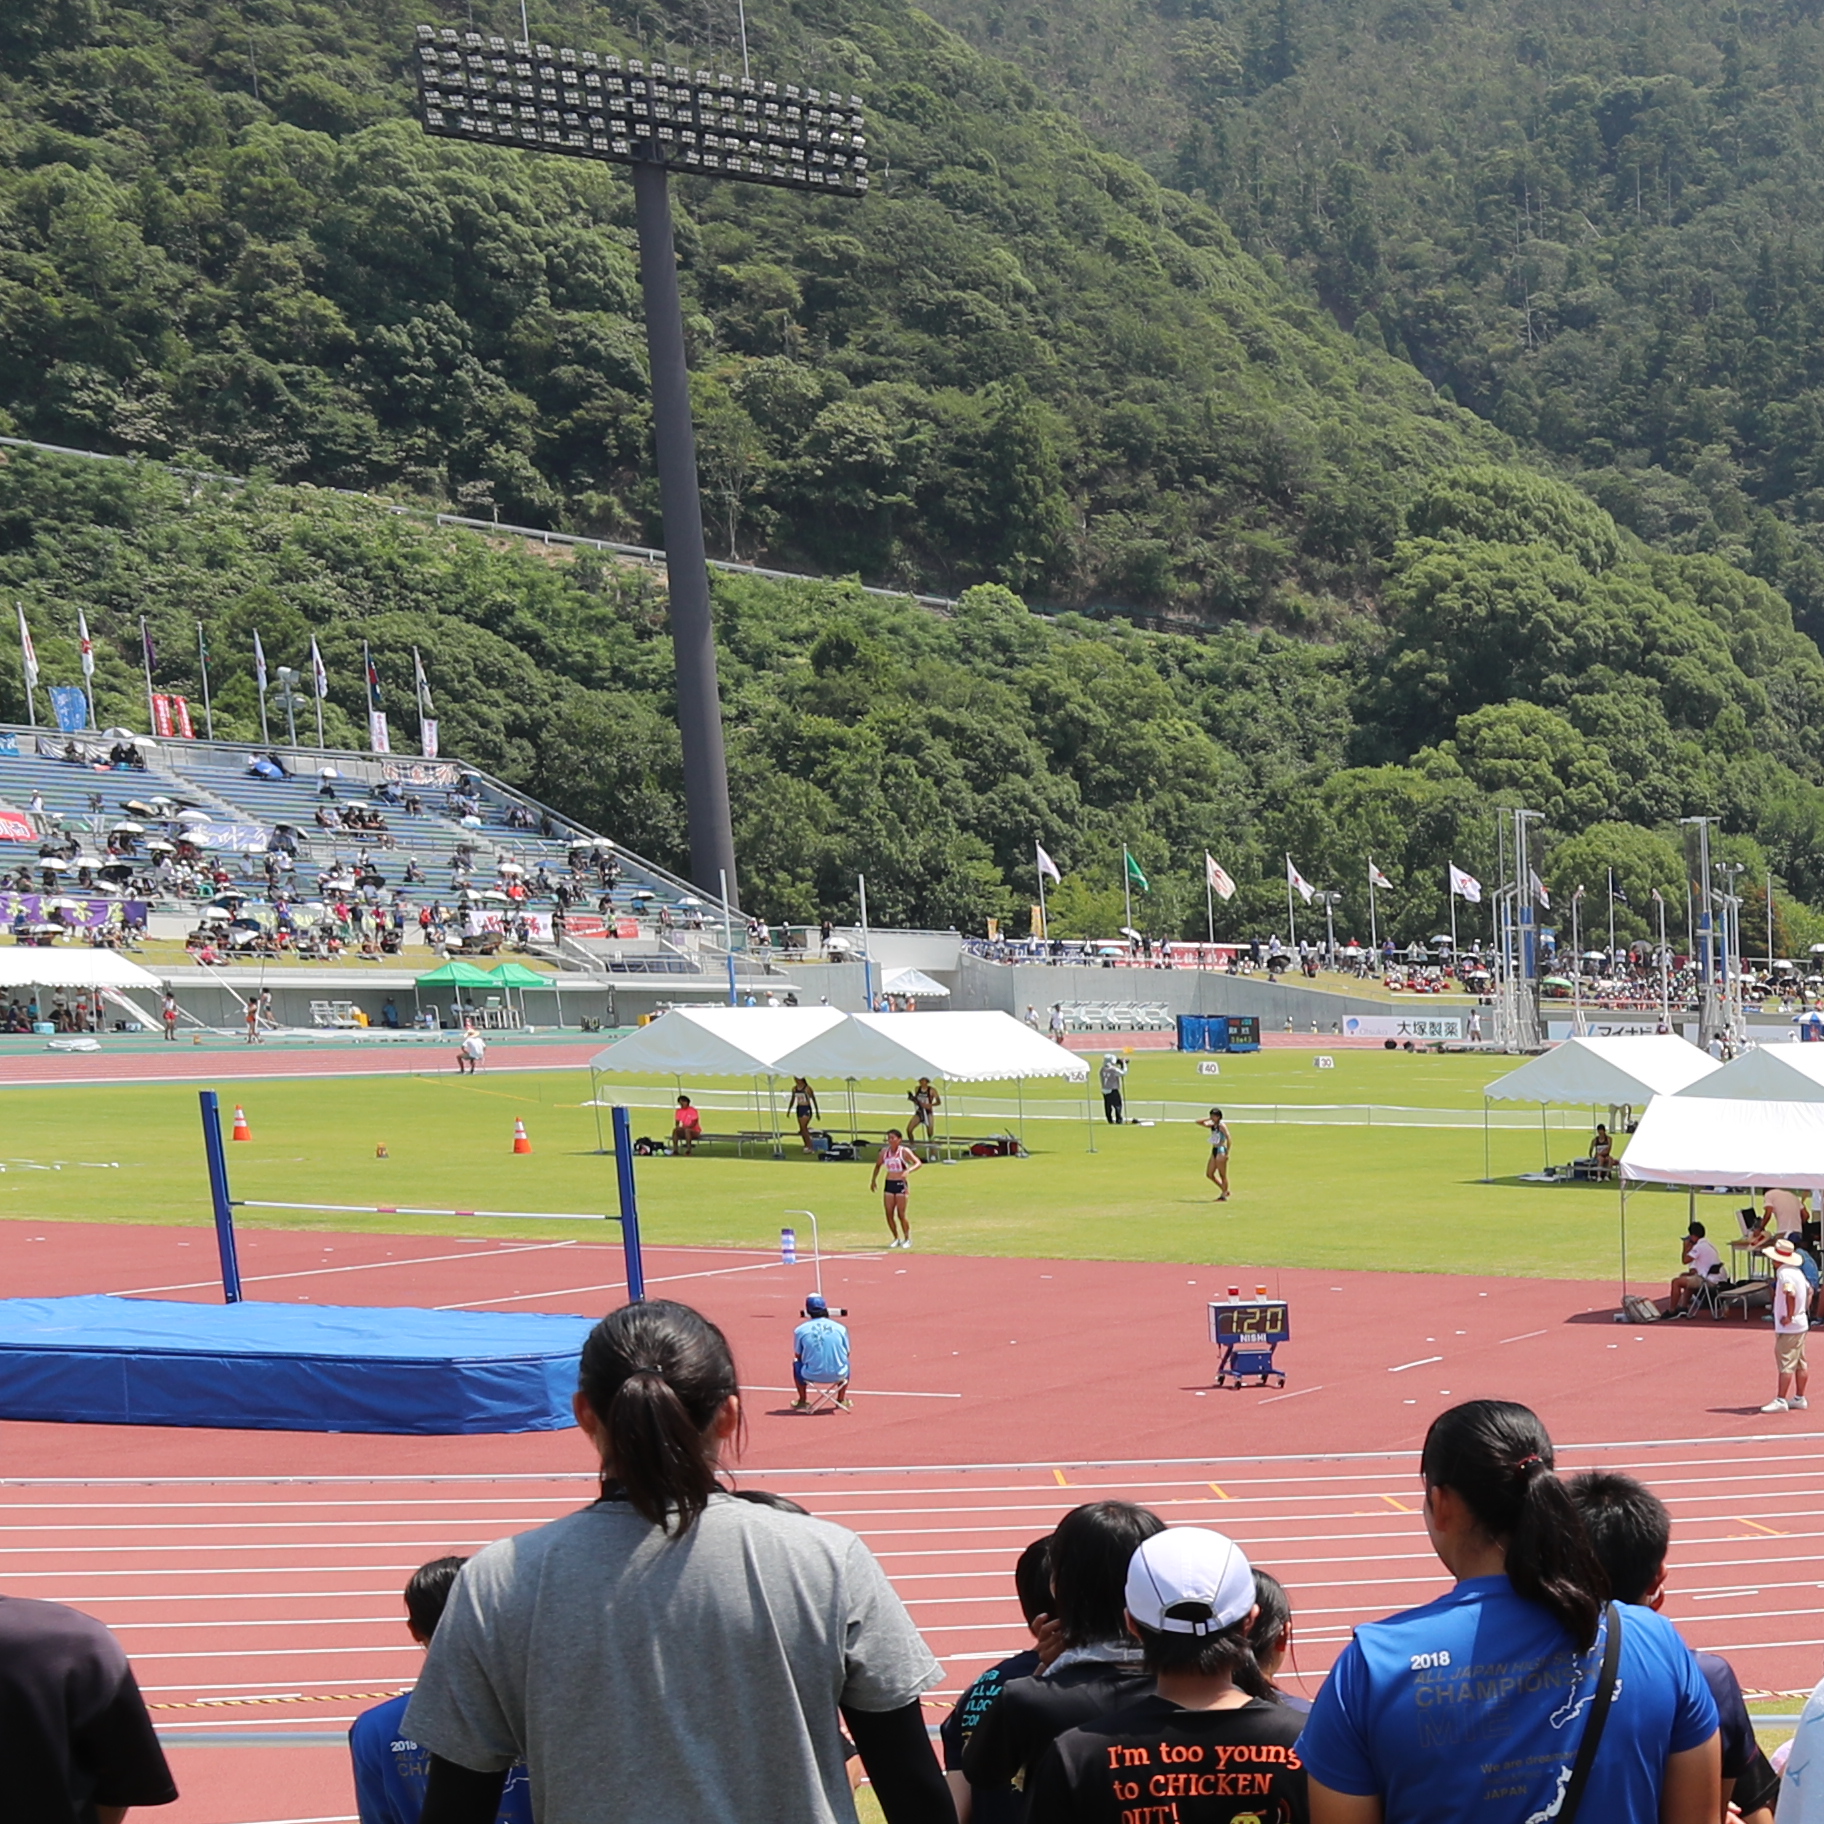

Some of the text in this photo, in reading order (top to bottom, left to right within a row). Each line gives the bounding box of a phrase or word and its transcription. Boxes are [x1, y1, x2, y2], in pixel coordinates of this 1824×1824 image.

[1397, 1021, 1458, 1038] 大塚製薬
[1204, 1064, 1217, 1074] 40
[1320, 1058, 1332, 1067] 30
[1410, 1650, 1451, 1671] 2018
[1413, 1671, 1446, 1686] ALL
[1450, 1664, 1508, 1681] JAPAN
[1416, 1698, 1513, 1749] MIE
[1107, 1743, 1152, 1770] I'm
[1157, 1741, 1206, 1766] too
[1112, 1772, 1273, 1800] to CHICKEN
[1483, 1785, 1528, 1801] JAPAN
